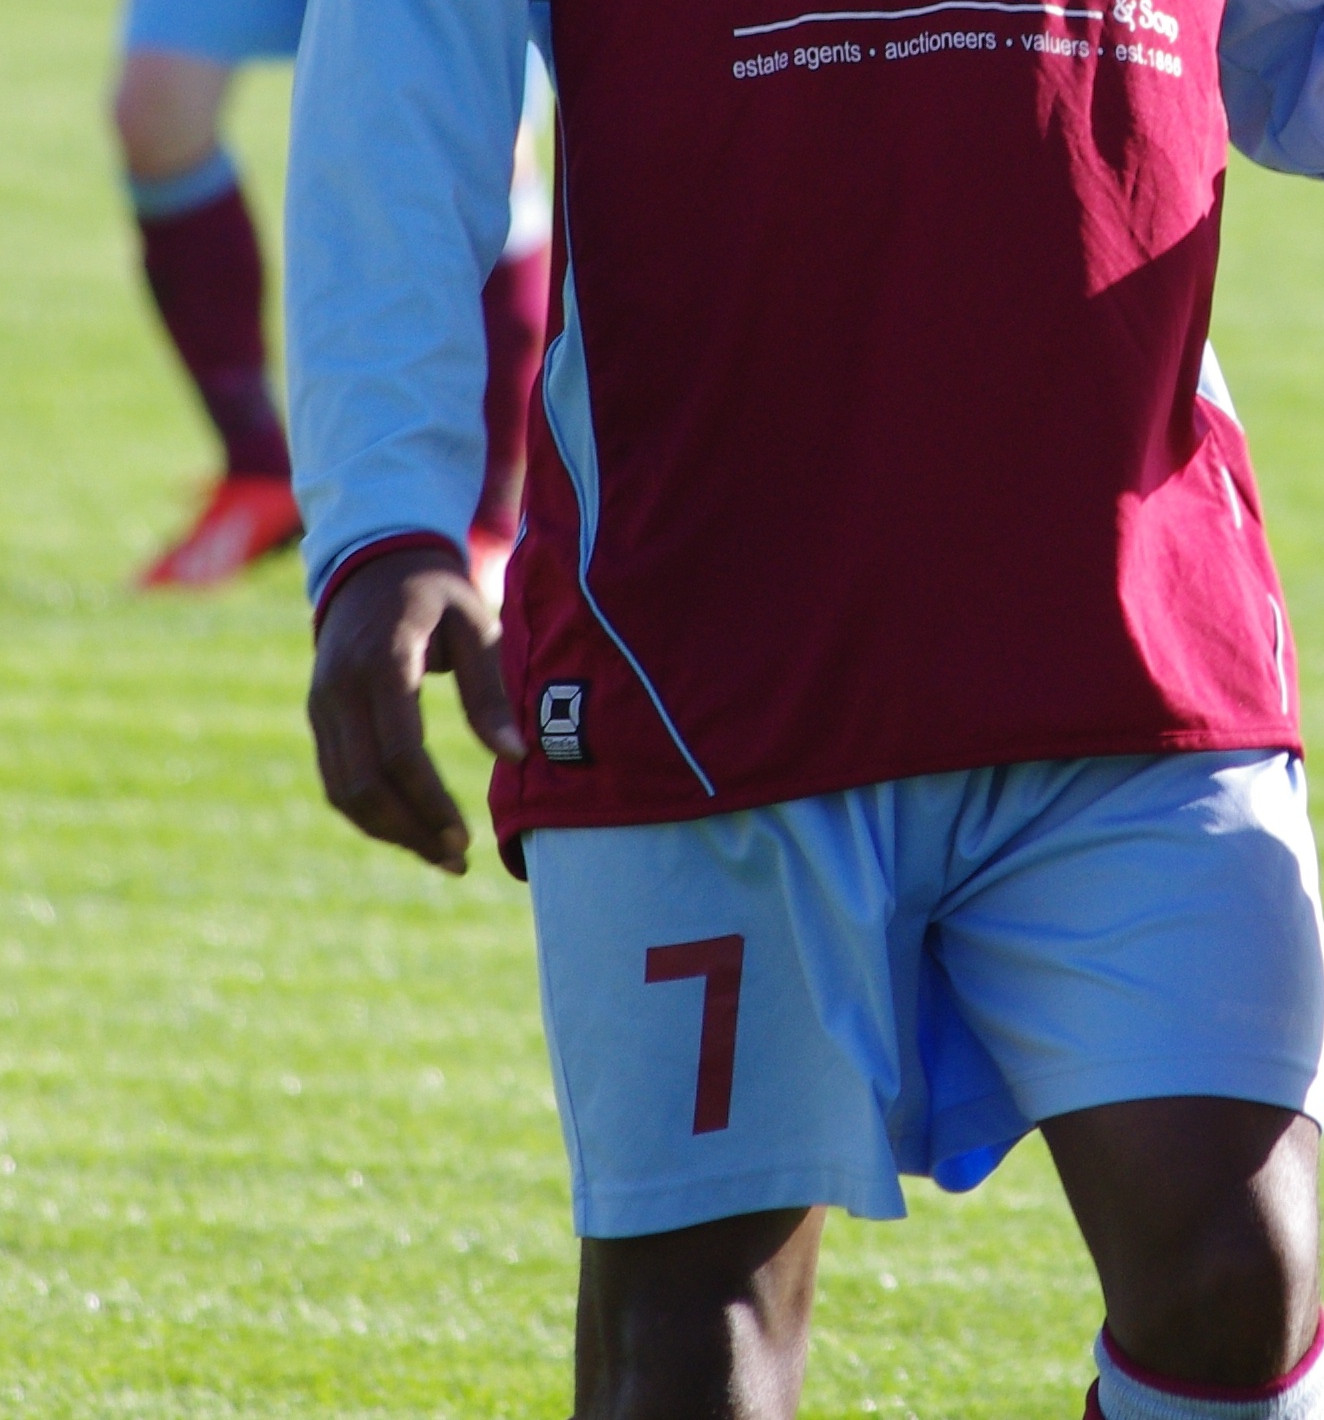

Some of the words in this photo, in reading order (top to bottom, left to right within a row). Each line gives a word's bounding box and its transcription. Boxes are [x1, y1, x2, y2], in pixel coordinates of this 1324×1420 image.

[732, 50, 789, 80] estate
[793, 40, 862, 70] agents
[885, 30, 997, 61] auctioneers
[1020, 30, 1091, 59] valuers
[644, 933, 745, 1136] 7
